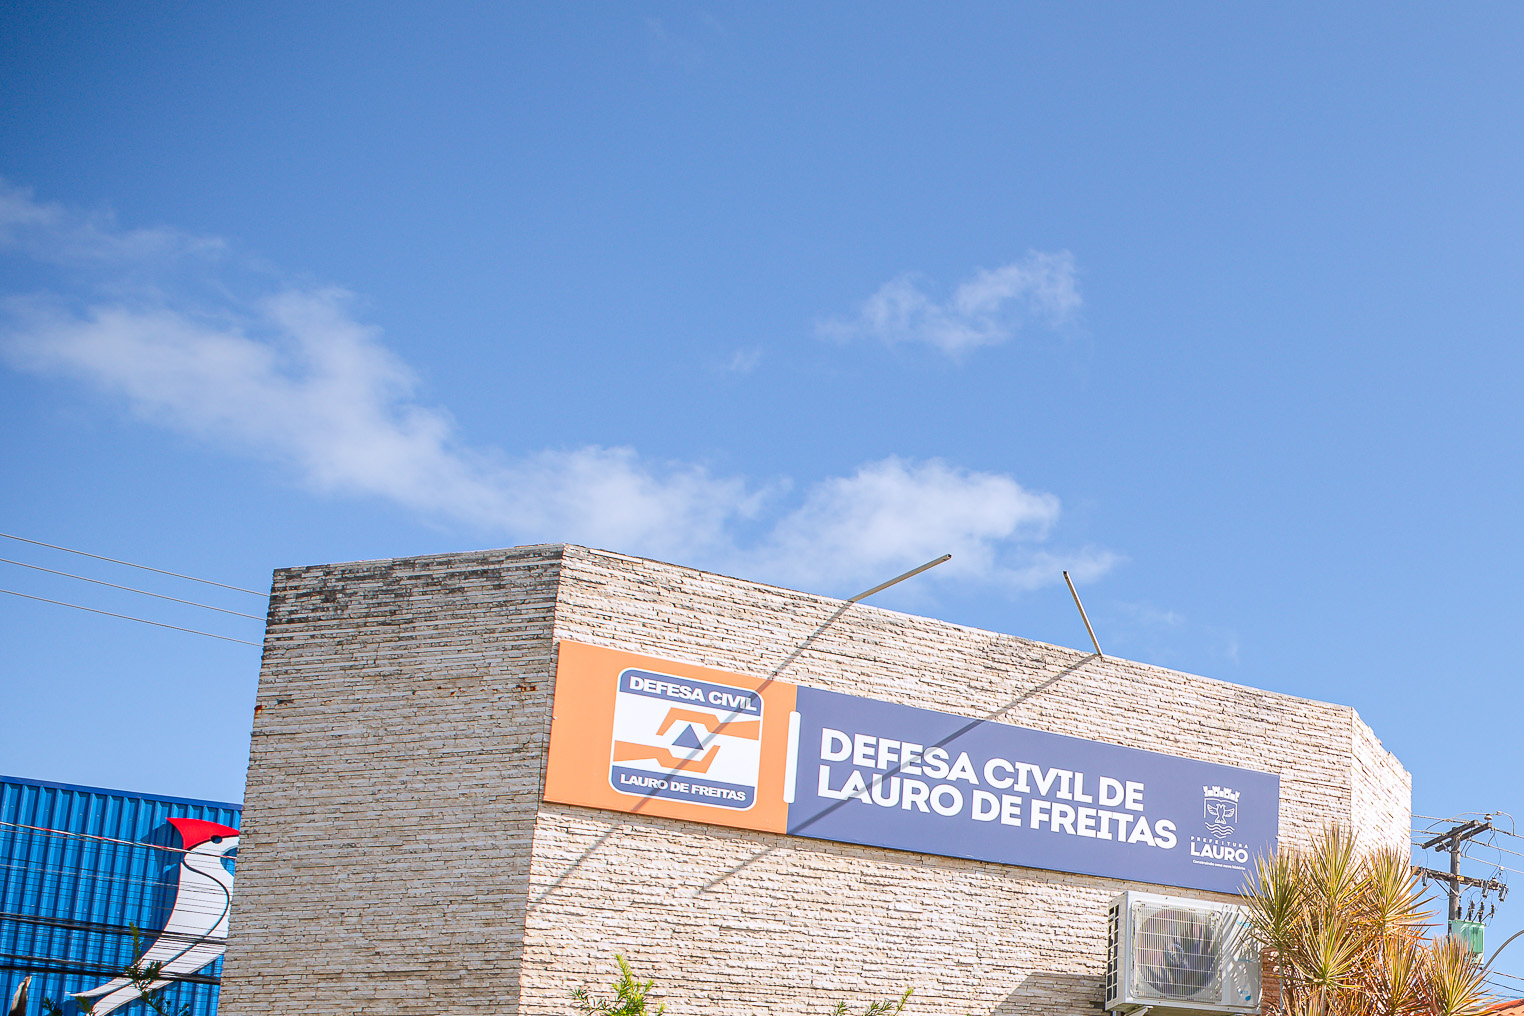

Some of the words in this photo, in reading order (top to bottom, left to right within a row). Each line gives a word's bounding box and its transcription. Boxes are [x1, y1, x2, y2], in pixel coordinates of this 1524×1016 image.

[629, 676, 706, 703] DEFESA
[708, 689, 758, 712] CIVIL
[819, 727, 980, 785] DEFESA
[983, 757, 1093, 805] CIVIL
[1098, 774, 1145, 813] DE
[620, 773, 669, 791] LAURO
[669, 781, 690, 794] DE
[690, 784, 747, 802] FREITAS
[817, 764, 963, 817] LAURO
[971, 791, 1023, 827] DE
[1030, 799, 1178, 850] FREITAS
[1190, 835, 1249, 849] PREFEITURA
[1190, 841, 1249, 864] LAURO
